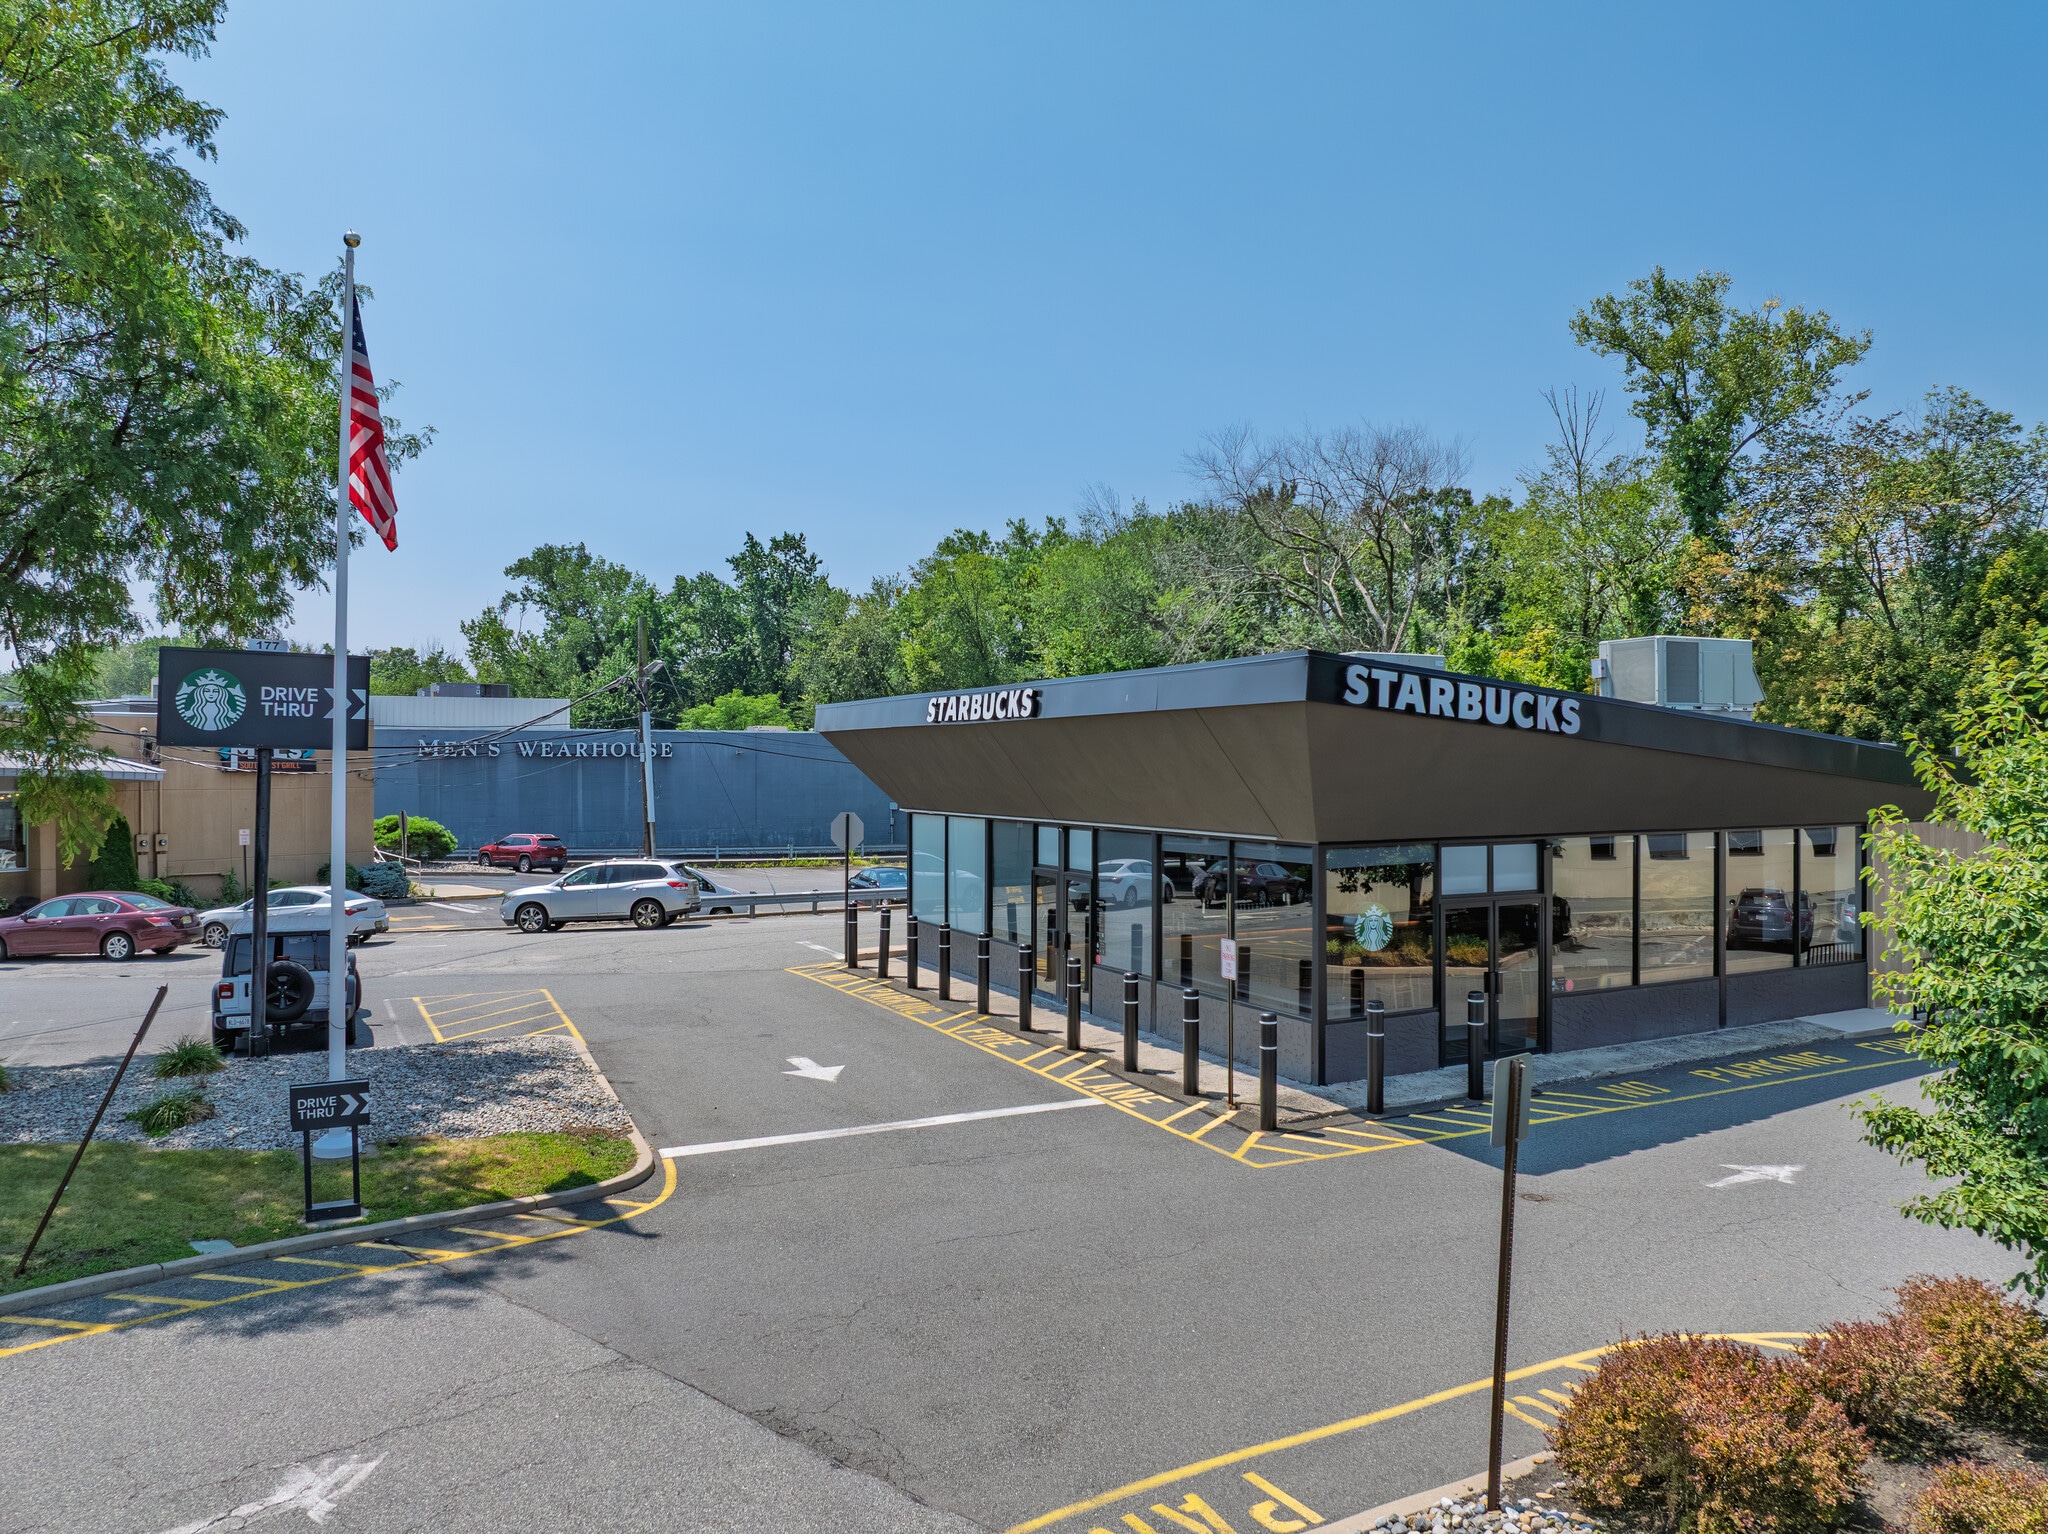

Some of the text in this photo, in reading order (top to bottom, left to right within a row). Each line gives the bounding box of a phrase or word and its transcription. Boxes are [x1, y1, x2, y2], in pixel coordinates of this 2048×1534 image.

[256, 641, 280, 650] 177
[260, 686, 319, 703] DRIVE
[1343, 664, 1581, 735] STARBUCKS
[260, 702, 315, 718] THRU
[926, 688, 1034, 723] STARBUCKS
[417, 739, 674, 758] MEN'S WEARHOUSE
[281, 761, 302, 769] GRILL
[956, 1027, 1032, 1049] FIRE
[1068, 1074, 1175, 1108] LANE
[1596, 1081, 1672, 1099] NO
[1688, 1051, 1850, 1083] PARKING
[297, 1096, 338, 1110] DRIVE
[298, 1107, 335, 1120] THRU
